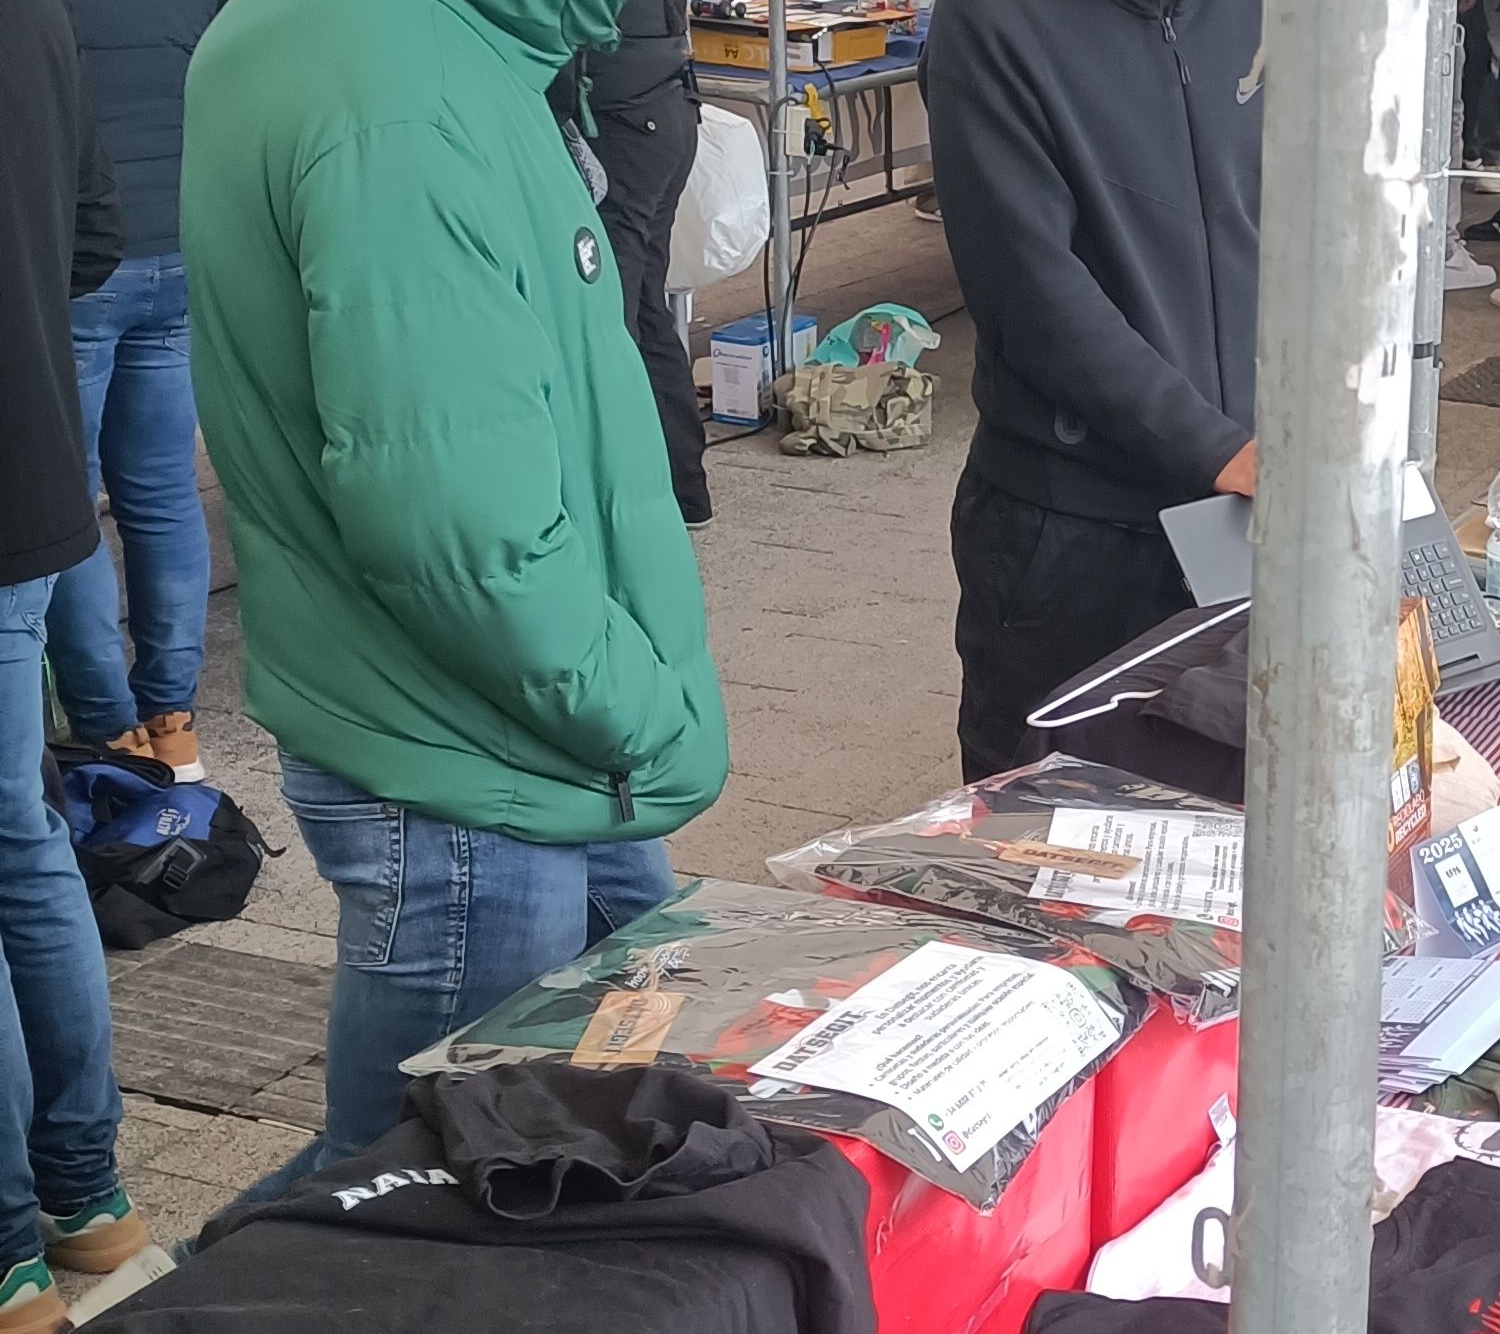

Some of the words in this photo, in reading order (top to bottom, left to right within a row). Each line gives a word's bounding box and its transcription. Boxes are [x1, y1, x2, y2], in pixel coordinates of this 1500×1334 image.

[1395, 803, 1427, 845] RECYCLED
[1419, 832, 1464, 866] 2025
[772, 1008, 865, 1077] DATSEGIT
